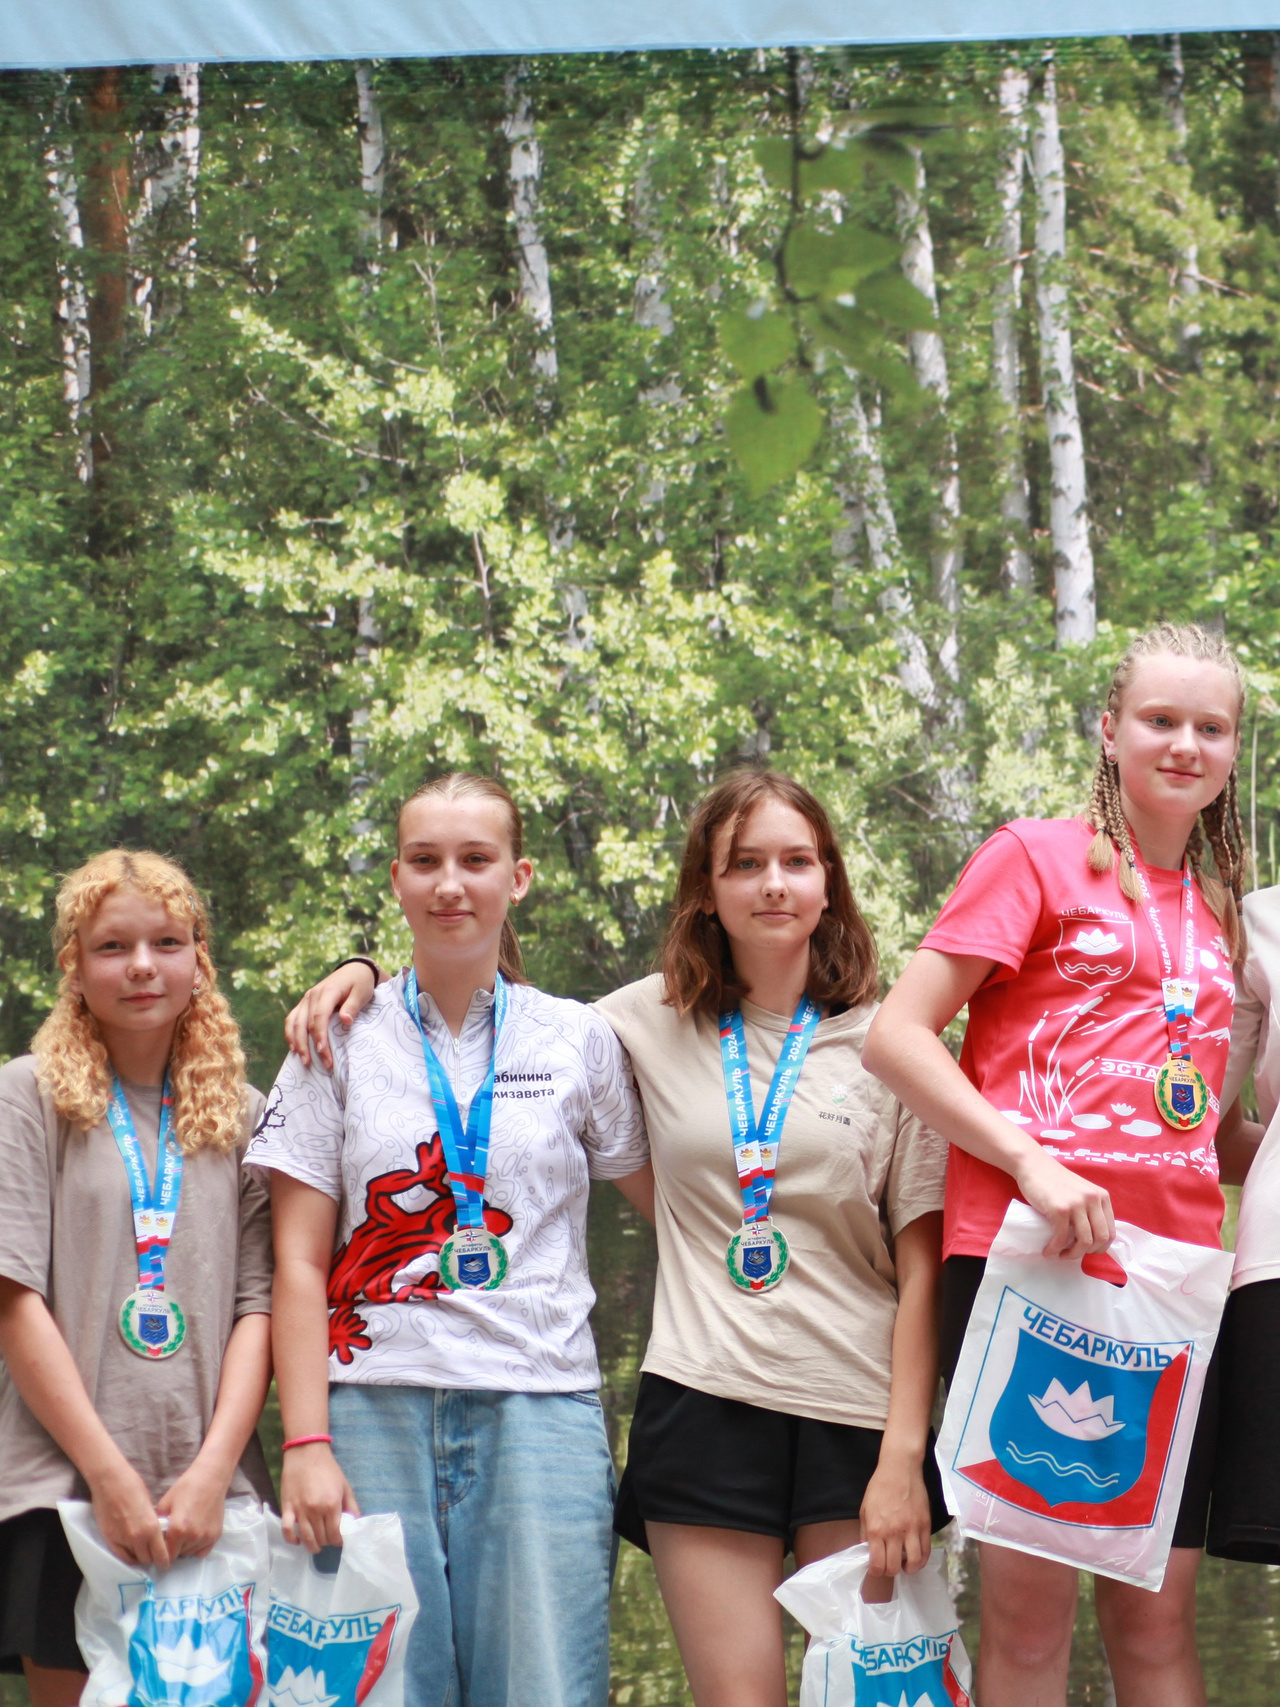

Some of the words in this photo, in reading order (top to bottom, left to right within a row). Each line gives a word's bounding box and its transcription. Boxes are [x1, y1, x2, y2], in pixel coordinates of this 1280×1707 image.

[1061, 904, 1130, 922] ЧЕБАРКУЛЬ
[1186, 888, 1194, 914] 2024
[1148, 906, 1173, 975] ЧЕБАРКУЛЬ
[1184, 918, 1195, 976] ЧЕБАРКУЛЬ
[727, 1033, 740, 1060] 2024
[1100, 1061, 1157, 1080] ЭСТА
[493, 1070, 552, 1084] абинина
[493, 1087, 555, 1099] лизавета
[733, 1067, 749, 1137] ЧЕБАРКУЛЬ
[764, 1068, 793, 1136] ЧЕБАРКУЛЬ
[787, 1035, 805, 1062] 2024
[122, 1134, 146, 1203] ЧЕБАРКУЛЬ
[159, 1141, 177, 1206] ЧЕБАРКУЬ
[1023, 1305, 1173, 1369] ЧЕБАРКУЛЬ
